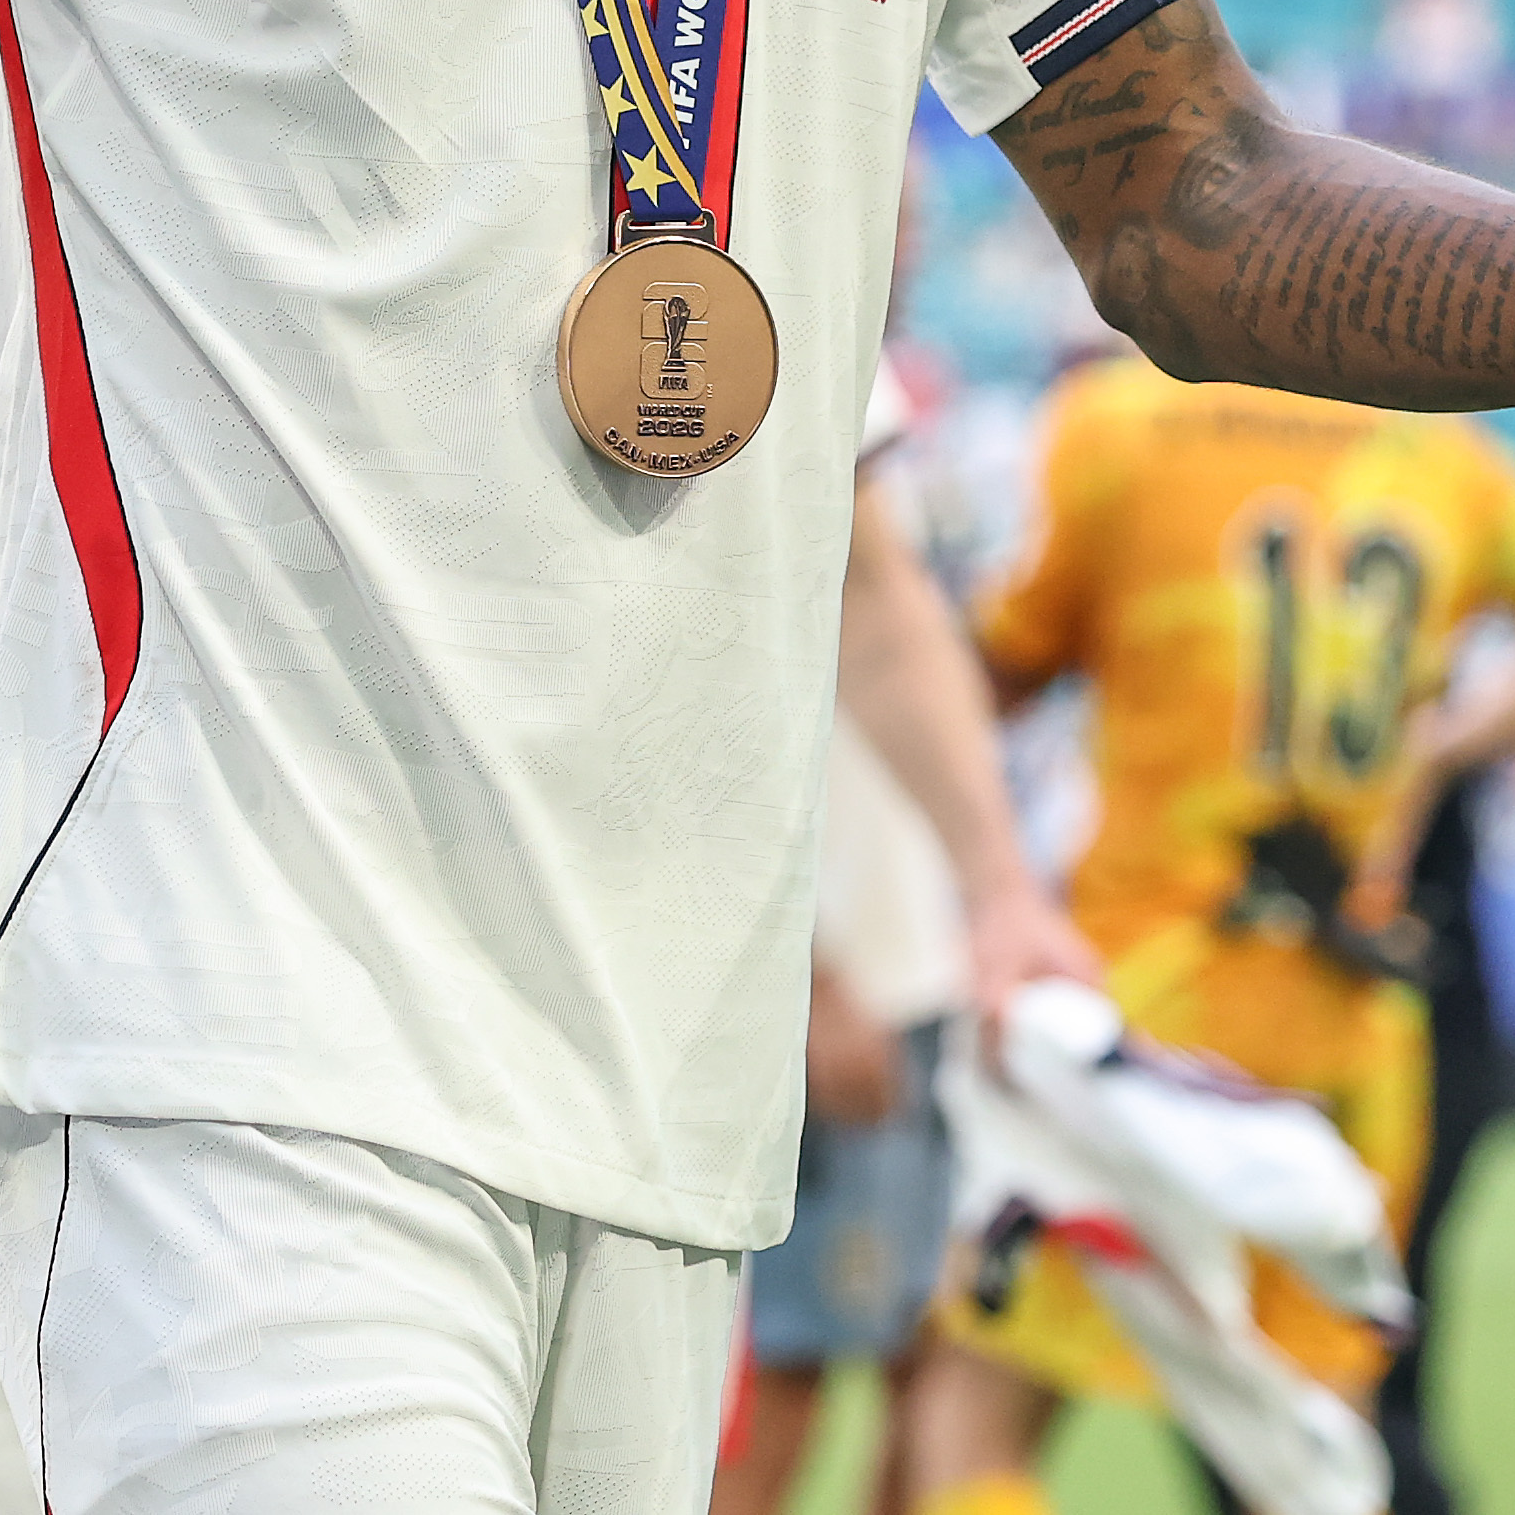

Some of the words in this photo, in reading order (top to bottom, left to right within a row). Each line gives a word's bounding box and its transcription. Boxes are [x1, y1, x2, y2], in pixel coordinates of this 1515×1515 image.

[669, 57, 700, 150] IFA
[658, 375, 689, 391] FIFA
[637, 403, 682, 417] WORLD
[682, 404, 706, 417] CUP
[637, 418, 705, 437] 2026
